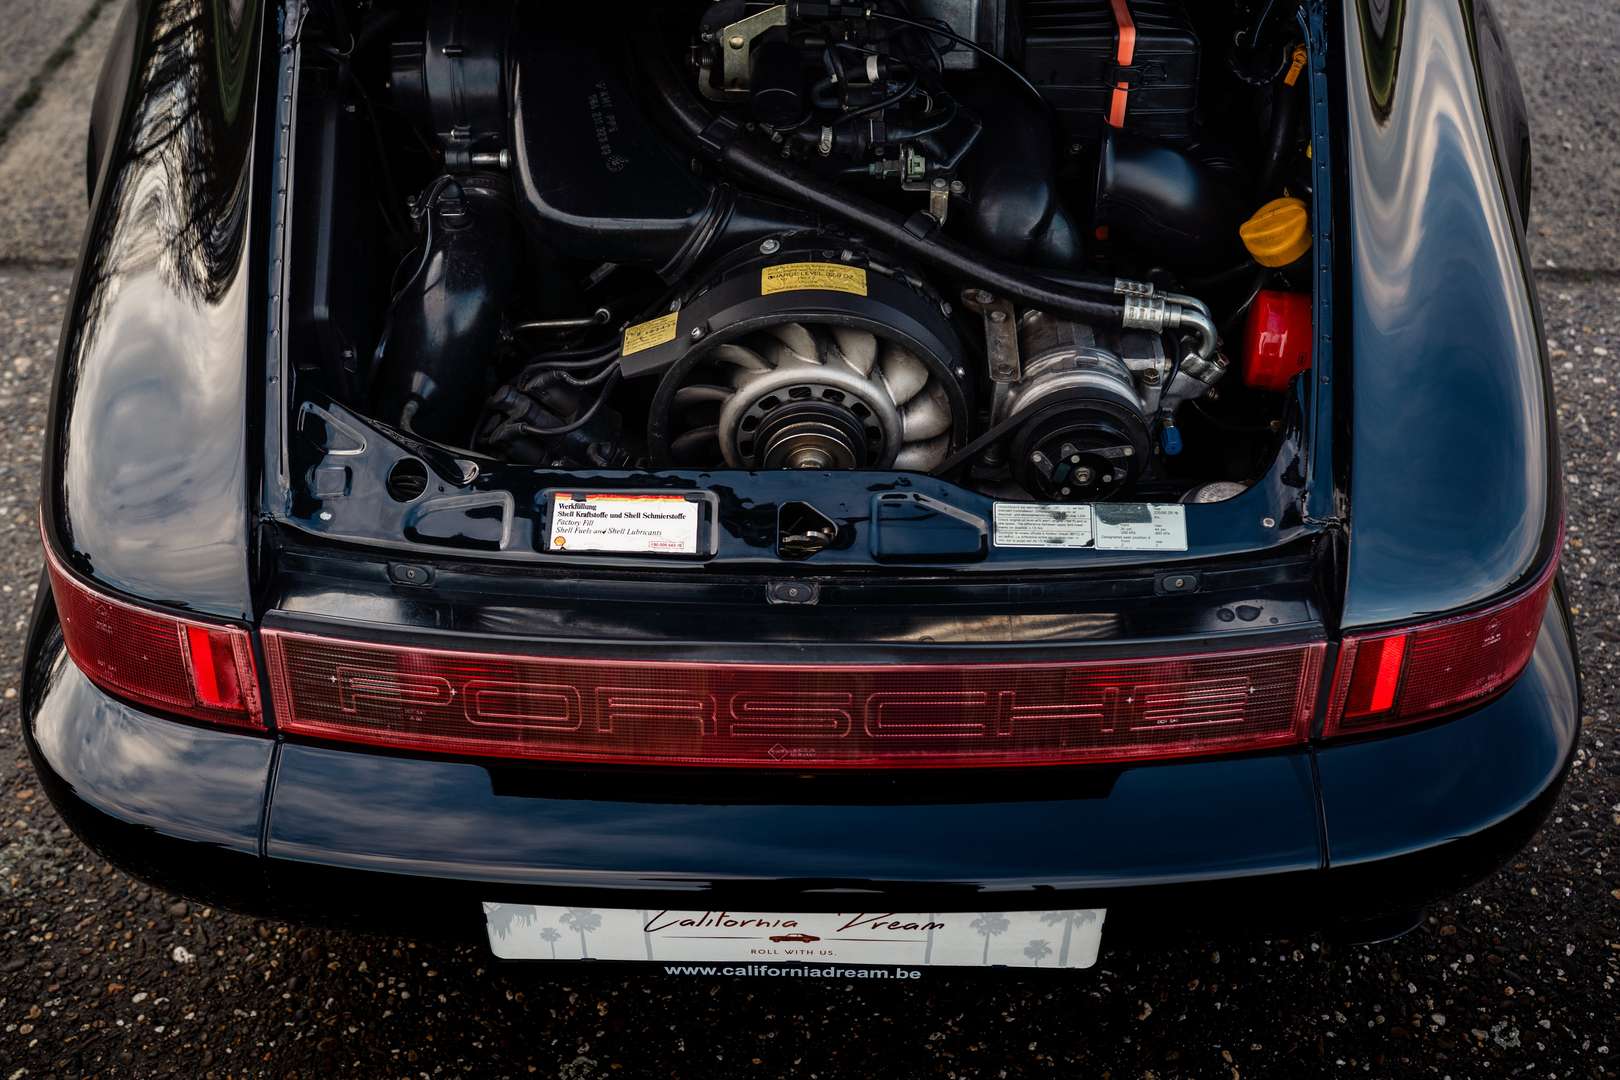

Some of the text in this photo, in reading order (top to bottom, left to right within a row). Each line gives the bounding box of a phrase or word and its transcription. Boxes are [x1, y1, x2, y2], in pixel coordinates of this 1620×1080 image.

[557, 510, 574, 518] Shell
[575, 511, 608, 519] Kraftstoffe
[623, 511, 641, 520] Shell
[642, 511, 687, 521] Schmierstoffe
[556, 518, 594, 527] Factory Fill
[555, 526, 573, 534] Shell
[574, 527, 592, 535] Fuels
[607, 527, 626, 536] Shell
[627, 527, 663, 537] Lubricants
[335, 665, 1252, 738] PORSCHE
[784, 948, 814, 956] WITH
[663, 964, 922, 980] www.californiadream.be
